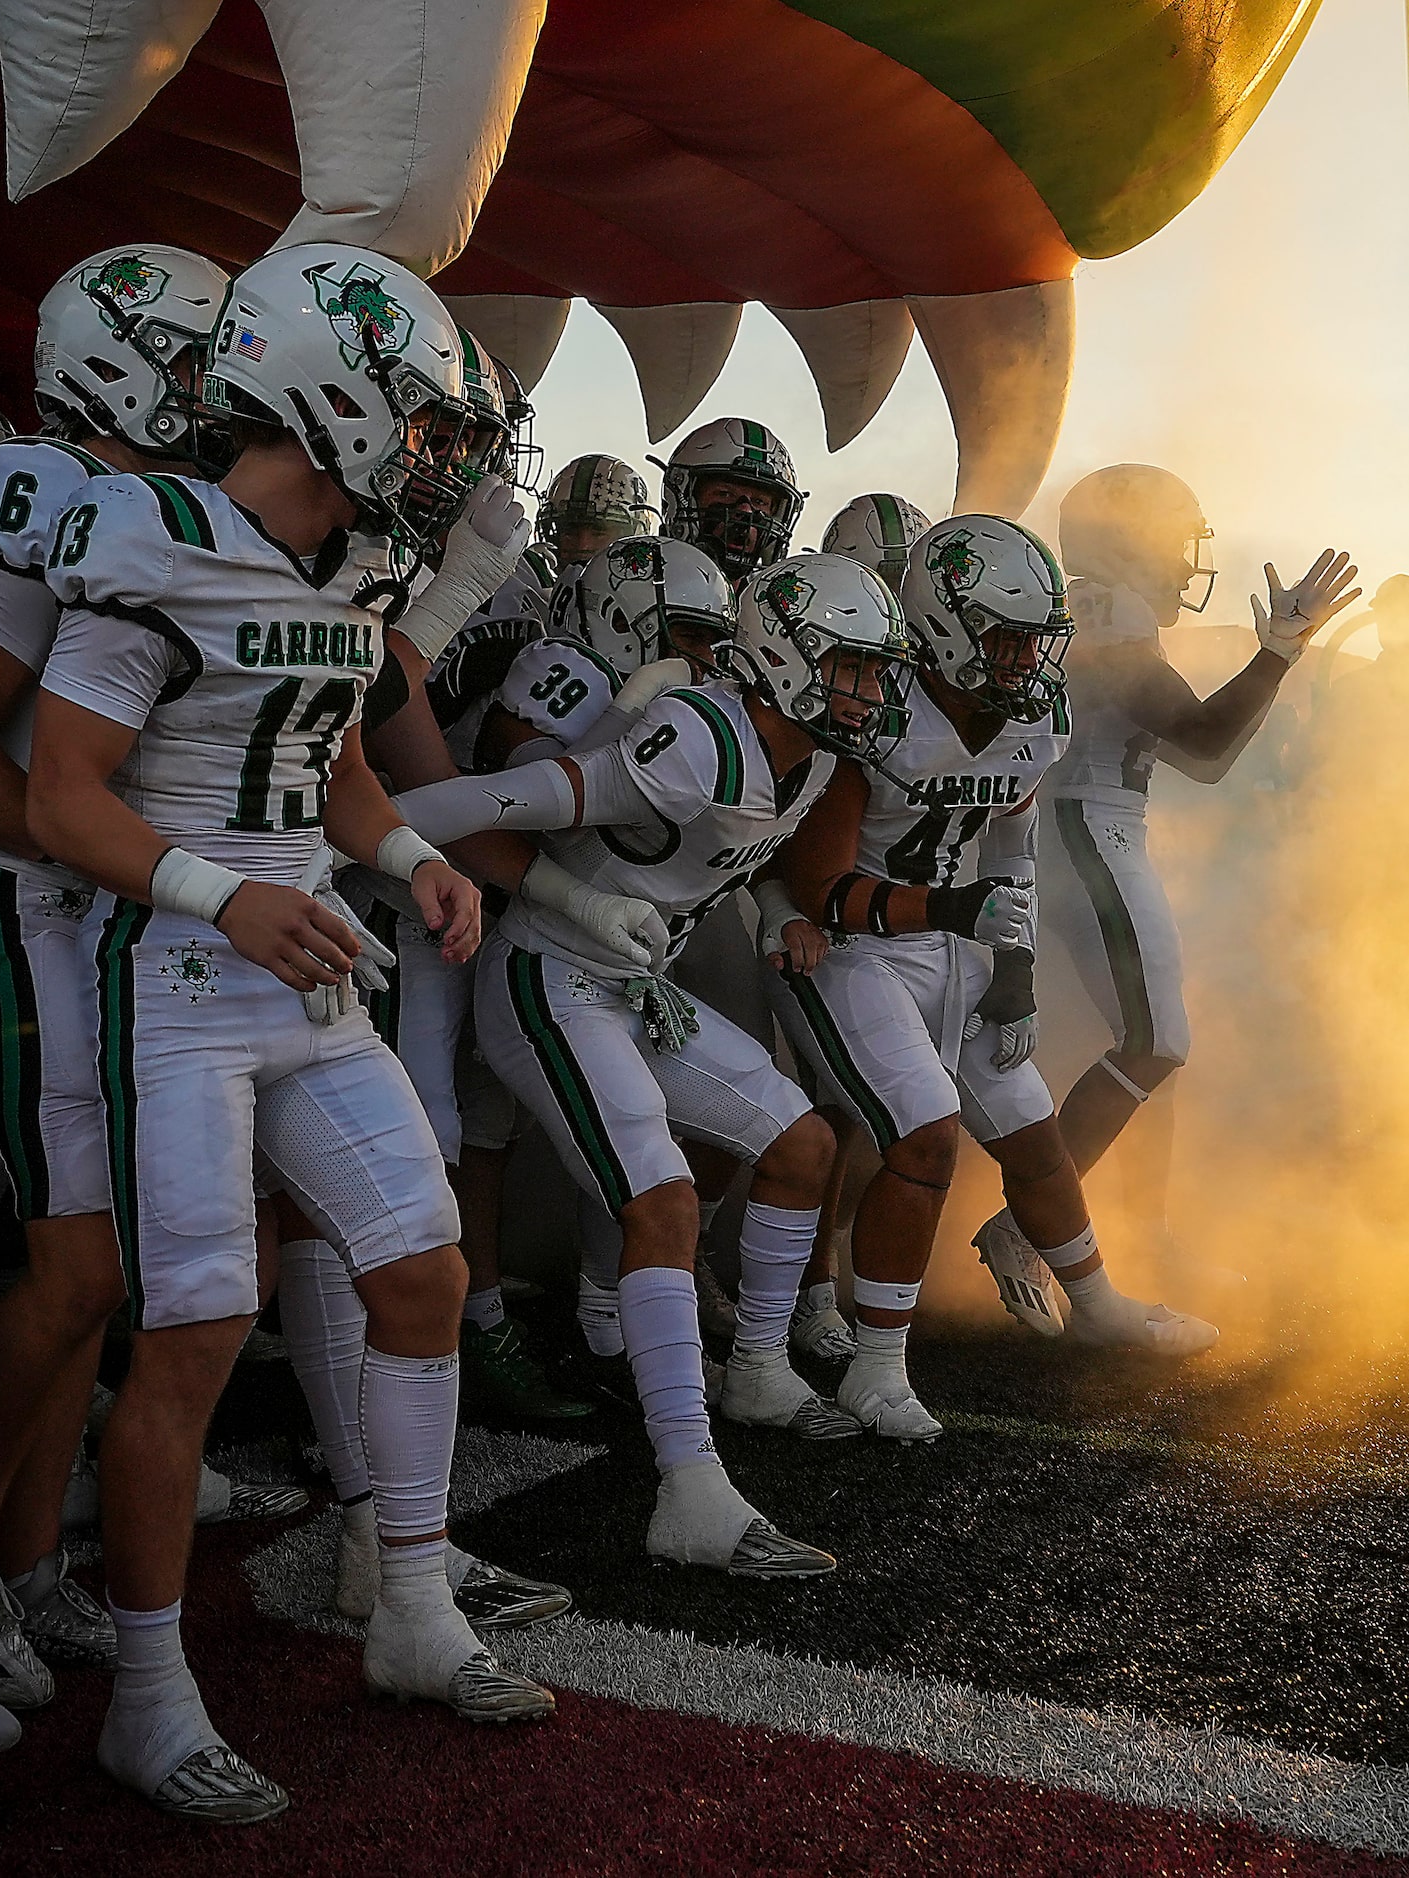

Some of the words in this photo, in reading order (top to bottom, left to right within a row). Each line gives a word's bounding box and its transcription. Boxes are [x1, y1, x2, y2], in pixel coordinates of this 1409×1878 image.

[47, 502, 100, 570] 13
[235, 620, 375, 668] CARROLL
[528, 662, 591, 721] 39
[225, 675, 358, 831] 13
[634, 722, 679, 767] 8
